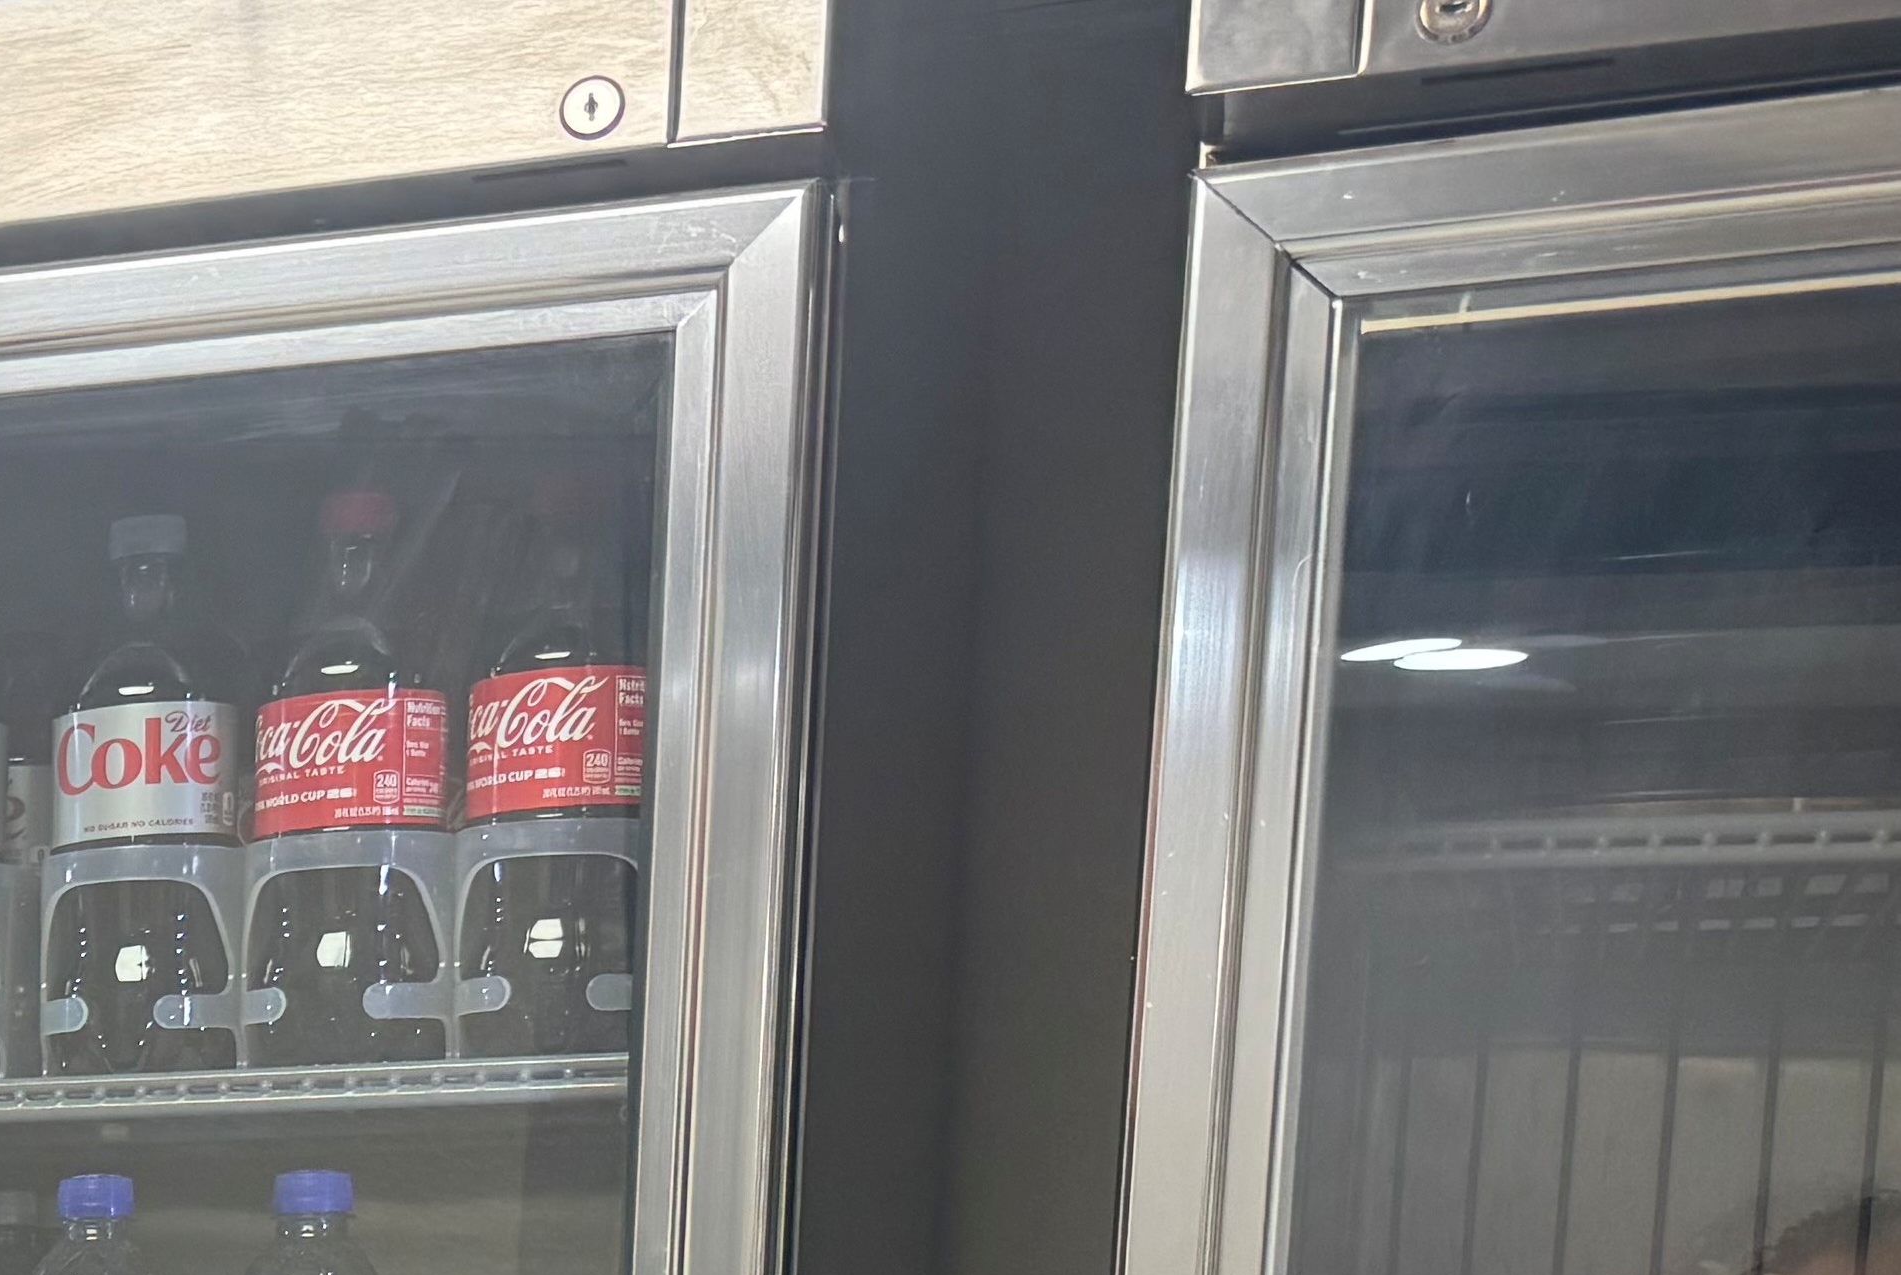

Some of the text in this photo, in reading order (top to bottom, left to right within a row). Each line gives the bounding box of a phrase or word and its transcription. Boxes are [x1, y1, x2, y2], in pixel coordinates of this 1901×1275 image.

[165, 710, 212, 734] Diet
[57, 716, 222, 795] Coke
[376, 772, 397, 788] 240
